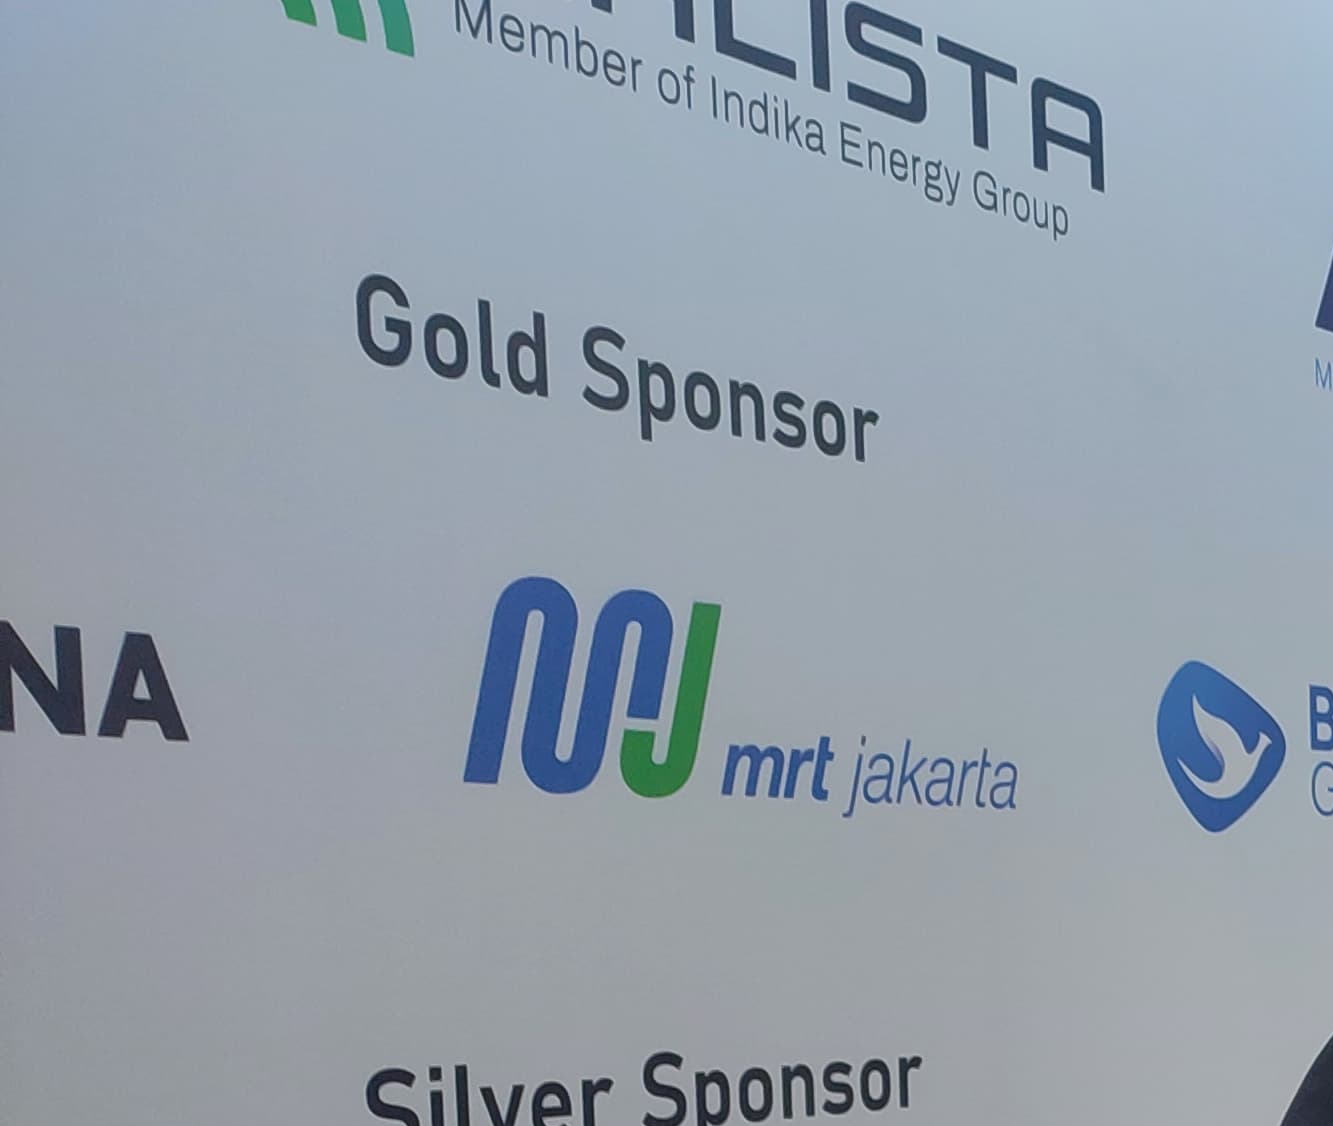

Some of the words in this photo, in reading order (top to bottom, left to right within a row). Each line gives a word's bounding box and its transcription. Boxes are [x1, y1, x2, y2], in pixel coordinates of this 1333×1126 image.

[455, 0, 643, 93] Member
[658, 65, 695, 109] of
[711, 76, 827, 156] Indika
[840, 121, 961, 207] Energy
[972, 170, 1070, 241] Group
[591, 0, 1106, 193] LISTA
[357, 274, 548, 397] Gold
[582, 325, 880, 463] Sponsor
[721, 735, 834, 801] mrt
[842, 736, 1018, 818] jakarta
